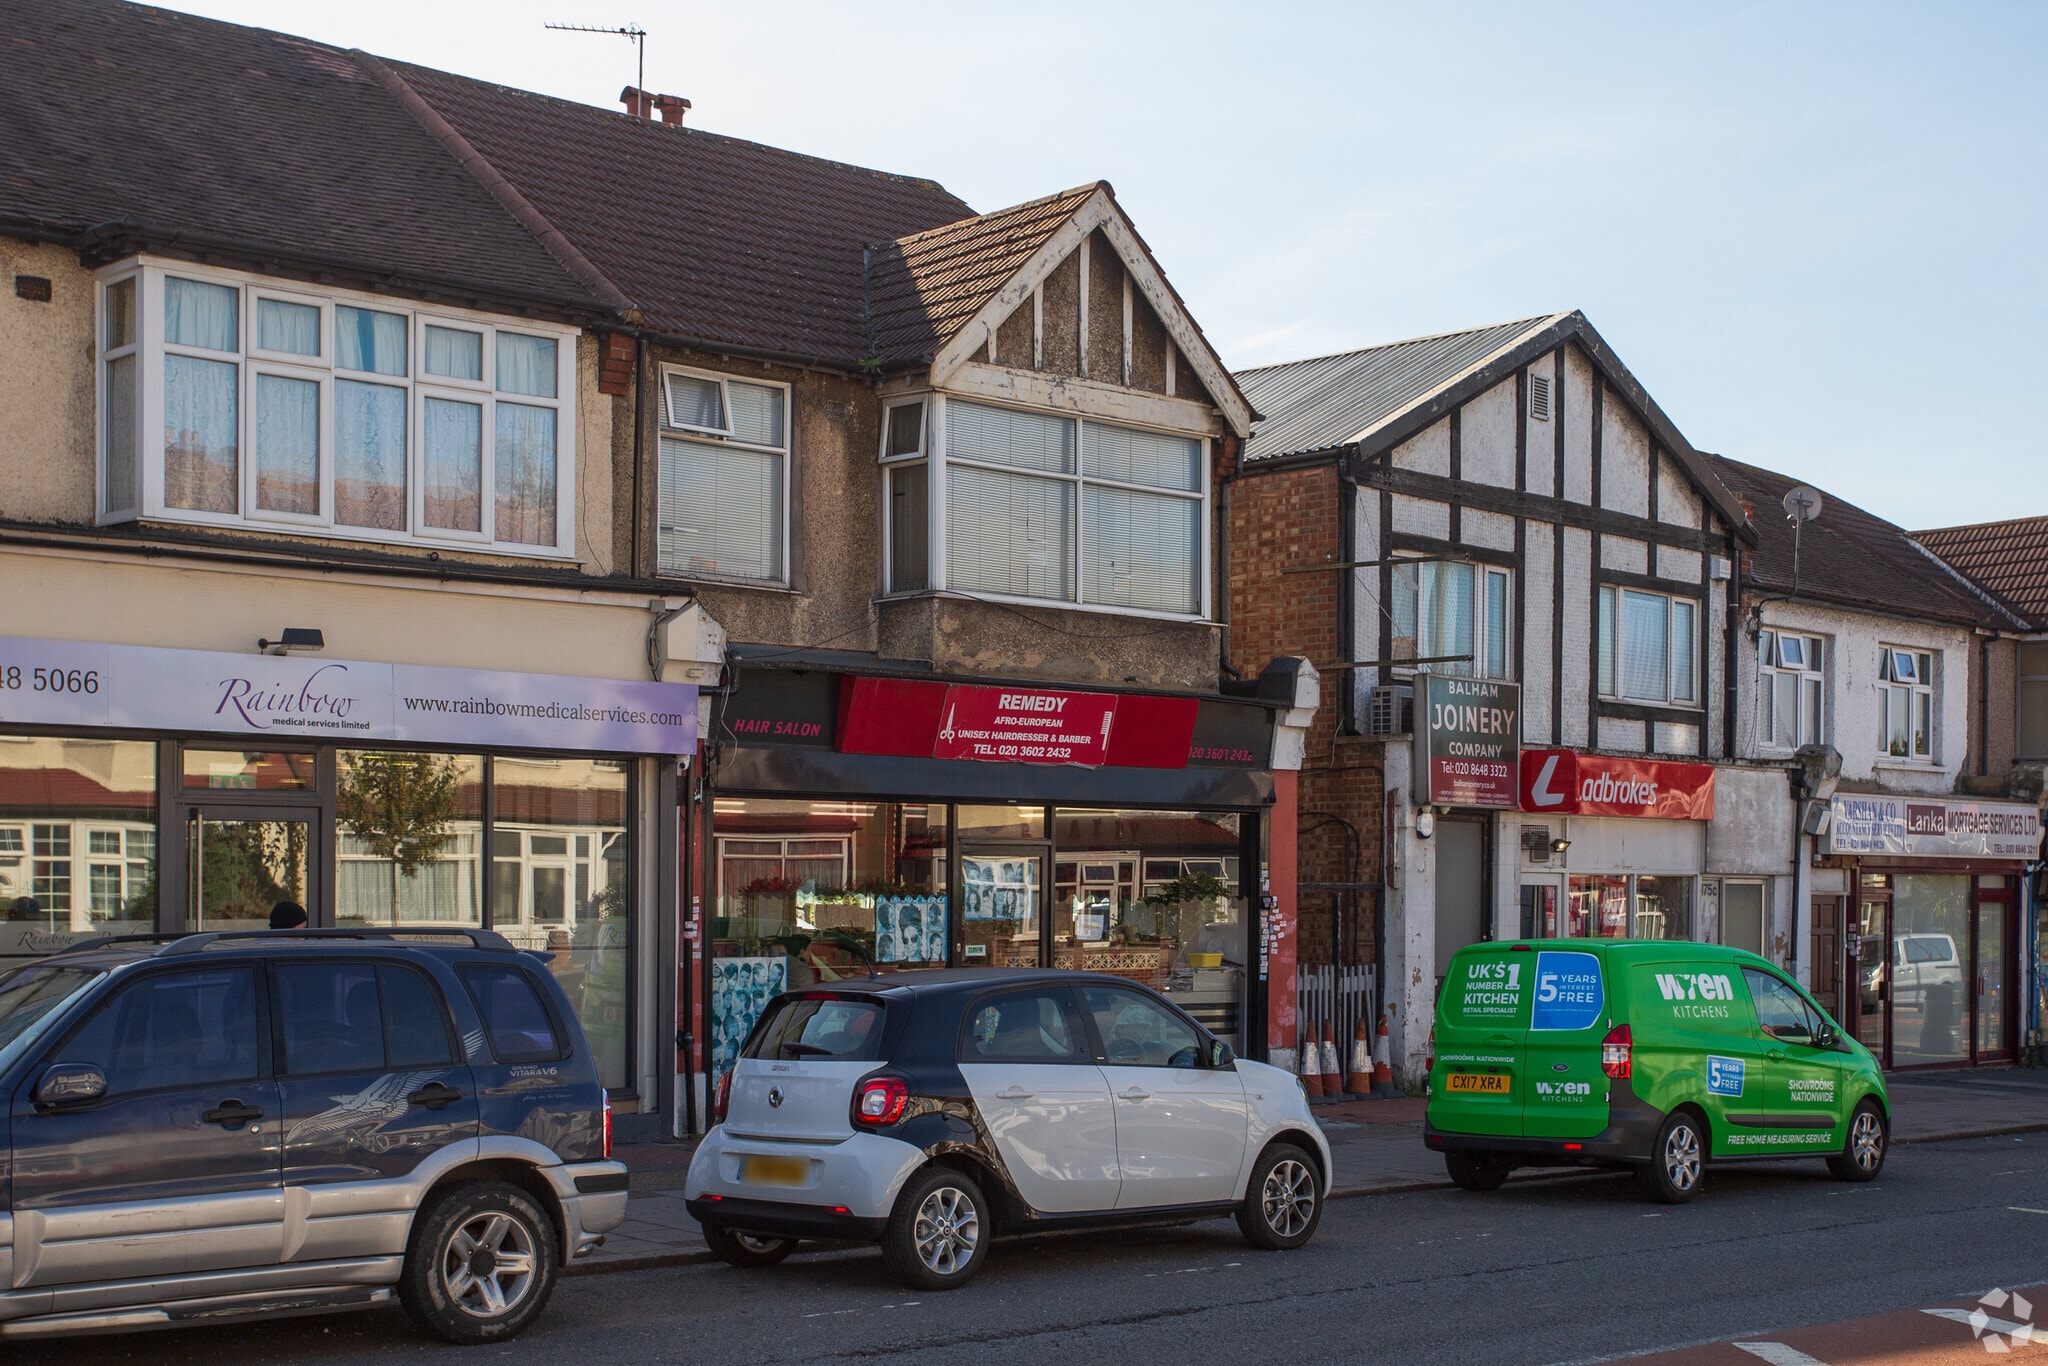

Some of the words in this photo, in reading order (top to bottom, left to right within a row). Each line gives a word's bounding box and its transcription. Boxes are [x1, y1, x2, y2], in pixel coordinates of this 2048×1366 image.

[34, 667, 99, 694] 5066
[215, 664, 360, 729] Rainbow
[1448, 681, 1499, 698] BALHAM
[998, 694, 1068, 713] REMEDY
[404, 697, 683, 726] www.rainbowmedicalservices.com
[272, 718, 305, 726] medical
[307, 719, 340, 729] services
[341, 720, 370, 730] limited
[994, 716, 1063, 727] AFRO-EUROPEAN
[1432, 703, 1515, 735] JOINERY
[734, 719, 771, 734] HAIR
[773, 721, 821, 736] SALON
[958, 730, 991, 739] UNISEX
[991, 731, 1049, 743] HAIRDRESSER
[1051, 734, 1057, 743] &
[1058, 734, 1091, 744] BARBER
[973, 744, 996, 755] TEL:
[999, 745, 1018, 756] 020
[1019, 746, 1047, 757] 3602
[1047, 747, 1072, 758] 2432
[1448, 741, 1502, 758] COMPANY
[1441, 761, 1454, 774] Tel:
[1455, 762, 1470, 775] 020
[1470, 764, 1489, 776] 8648
[1490, 765, 1508, 778] 3322
[1579, 772, 1658, 806] adbrokes
[1878, 802, 1885, 822] &
[1885, 802, 1896, 822] CO
[1908, 808, 1945, 834] Lanka
[1947, 811, 1989, 834] MORTGAGE
[1989, 813, 2023, 835] SERVICES
[2024, 815, 2037, 836] LTD
[1994, 843, 2005, 854] TEL:
[1468, 962, 1507, 979] UK'S
[1505, 964, 1521, 990] 1
[1561, 974, 1597, 984] YEARS
[1466, 982, 1503, 990] NUMBER
[1538, 974, 1558, 1002] 5
[1655, 973, 1734, 1000] wren
[1464, 993, 1519, 1005] KITCHEN
[1559, 992, 1594, 1003] FREE
[1672, 1005, 1729, 1018] KITCHENS
[510, 1069, 542, 1077] VITARA
[542, 1066, 557, 1075] V6
[1711, 1062, 1721, 1088] 5
[1721, 1063, 1740, 1073] YEARS
[1452, 1076, 1478, 1089] CX17
[1480, 1076, 1502, 1090] XRA
[1536, 1081, 1590, 1095] wren
[1721, 1079, 1739, 1090] FREE
[1788, 1079, 1834, 1091] SHOWROOMS
[1791, 1091, 1834, 1102] NATIONWIDE
[1727, 1135, 1745, 1145] FREE
[1745, 1134, 1767, 1144] HOME
[1767, 1134, 1806, 1144] MEASURING
[1806, 1133, 1831, 1144] SERVICE
